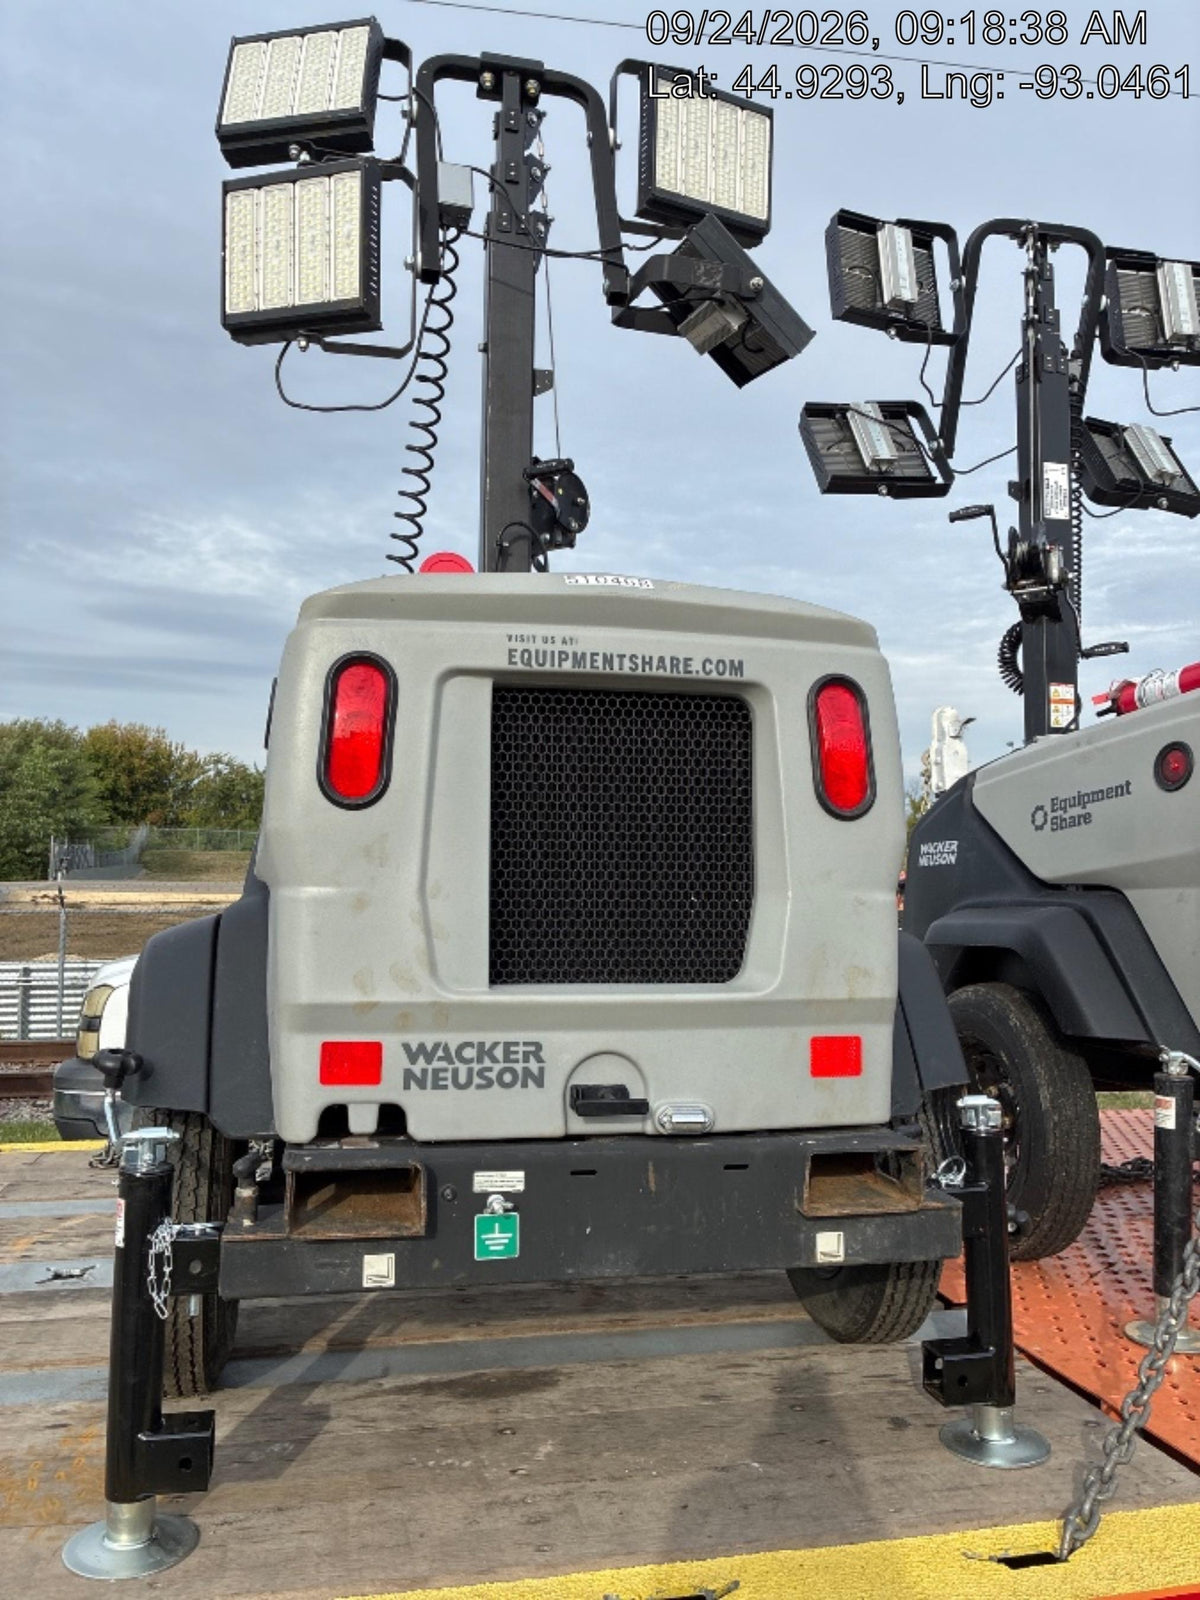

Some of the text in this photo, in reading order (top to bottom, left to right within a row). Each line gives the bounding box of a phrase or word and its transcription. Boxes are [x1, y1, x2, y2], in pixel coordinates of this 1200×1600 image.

[506, 634, 536, 644] VISIT
[542, 636, 556, 644] US
[507, 648, 744, 678] EQUIPMENTSHARE.COM
[1050, 780, 1132, 814] Equipment
[1050, 812, 1092, 832] Share
[920, 840, 958, 855] WACKER
[918, 853, 957, 866] NEUSON
[401, 1041, 546, 1065] WACKER
[403, 1066, 545, 1090] NEUSON
